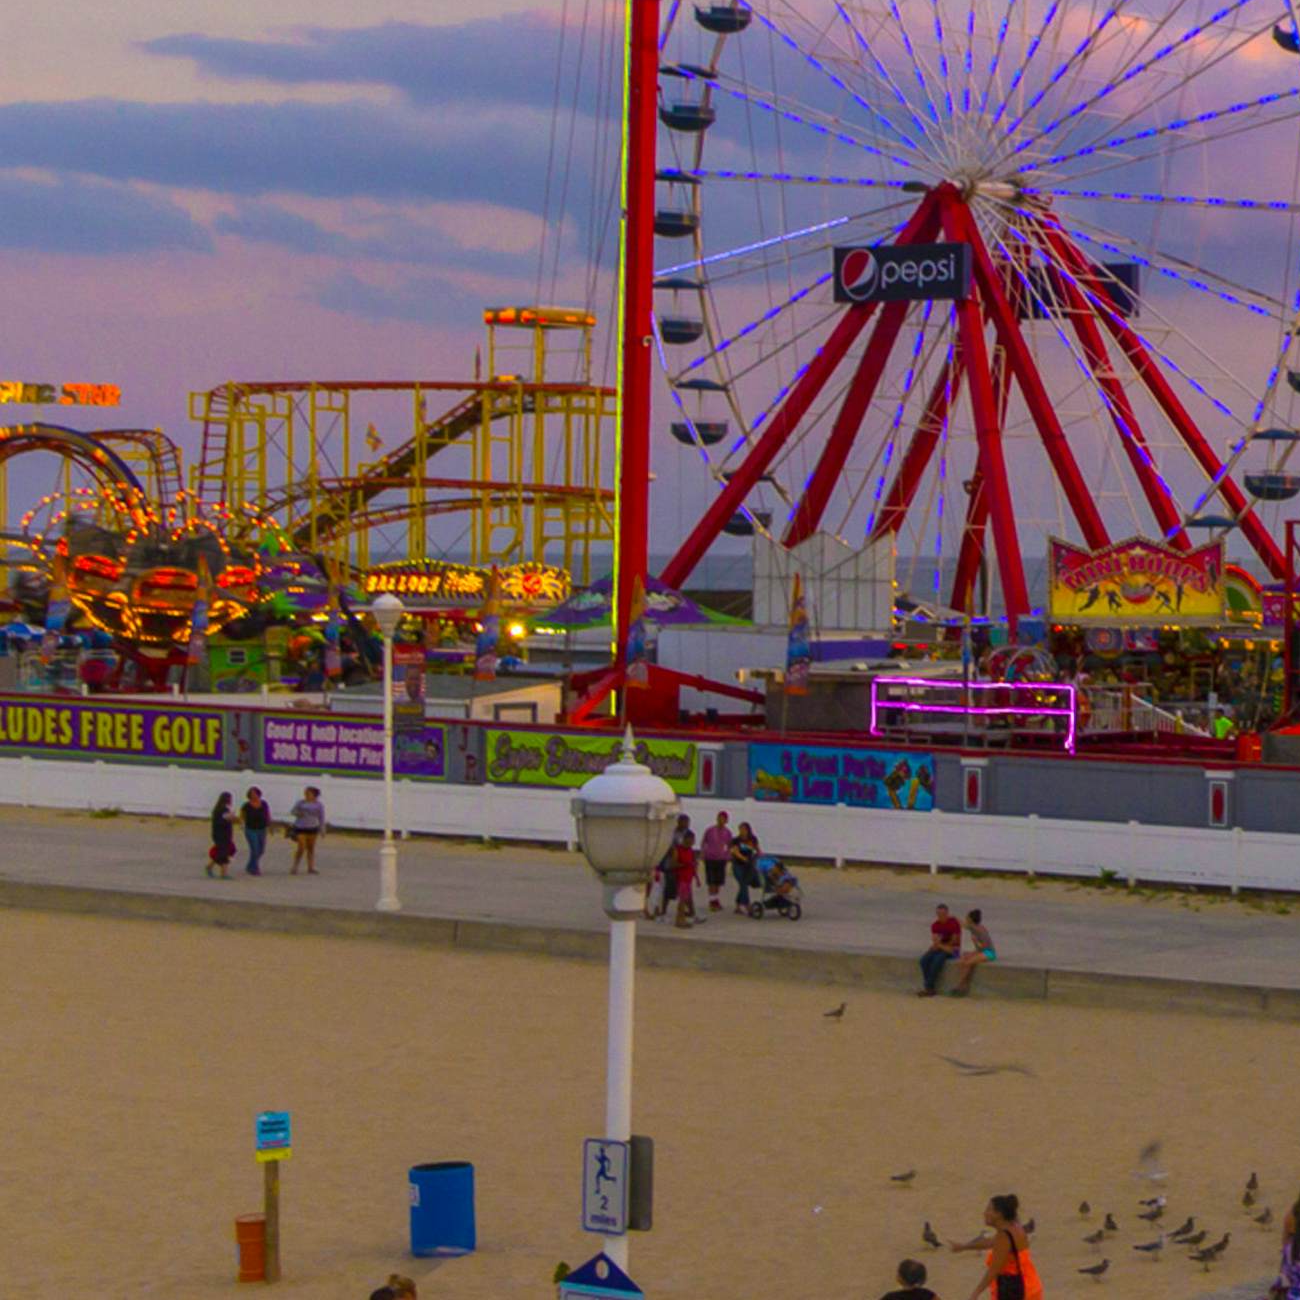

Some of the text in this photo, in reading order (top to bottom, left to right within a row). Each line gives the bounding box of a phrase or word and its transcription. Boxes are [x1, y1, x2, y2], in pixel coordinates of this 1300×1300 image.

[881, 253, 955, 289] pepsi
[79, 710, 144, 750] FREE
[152, 715, 221, 755] GOLF
[601, 1195, 608, 1210] 2
